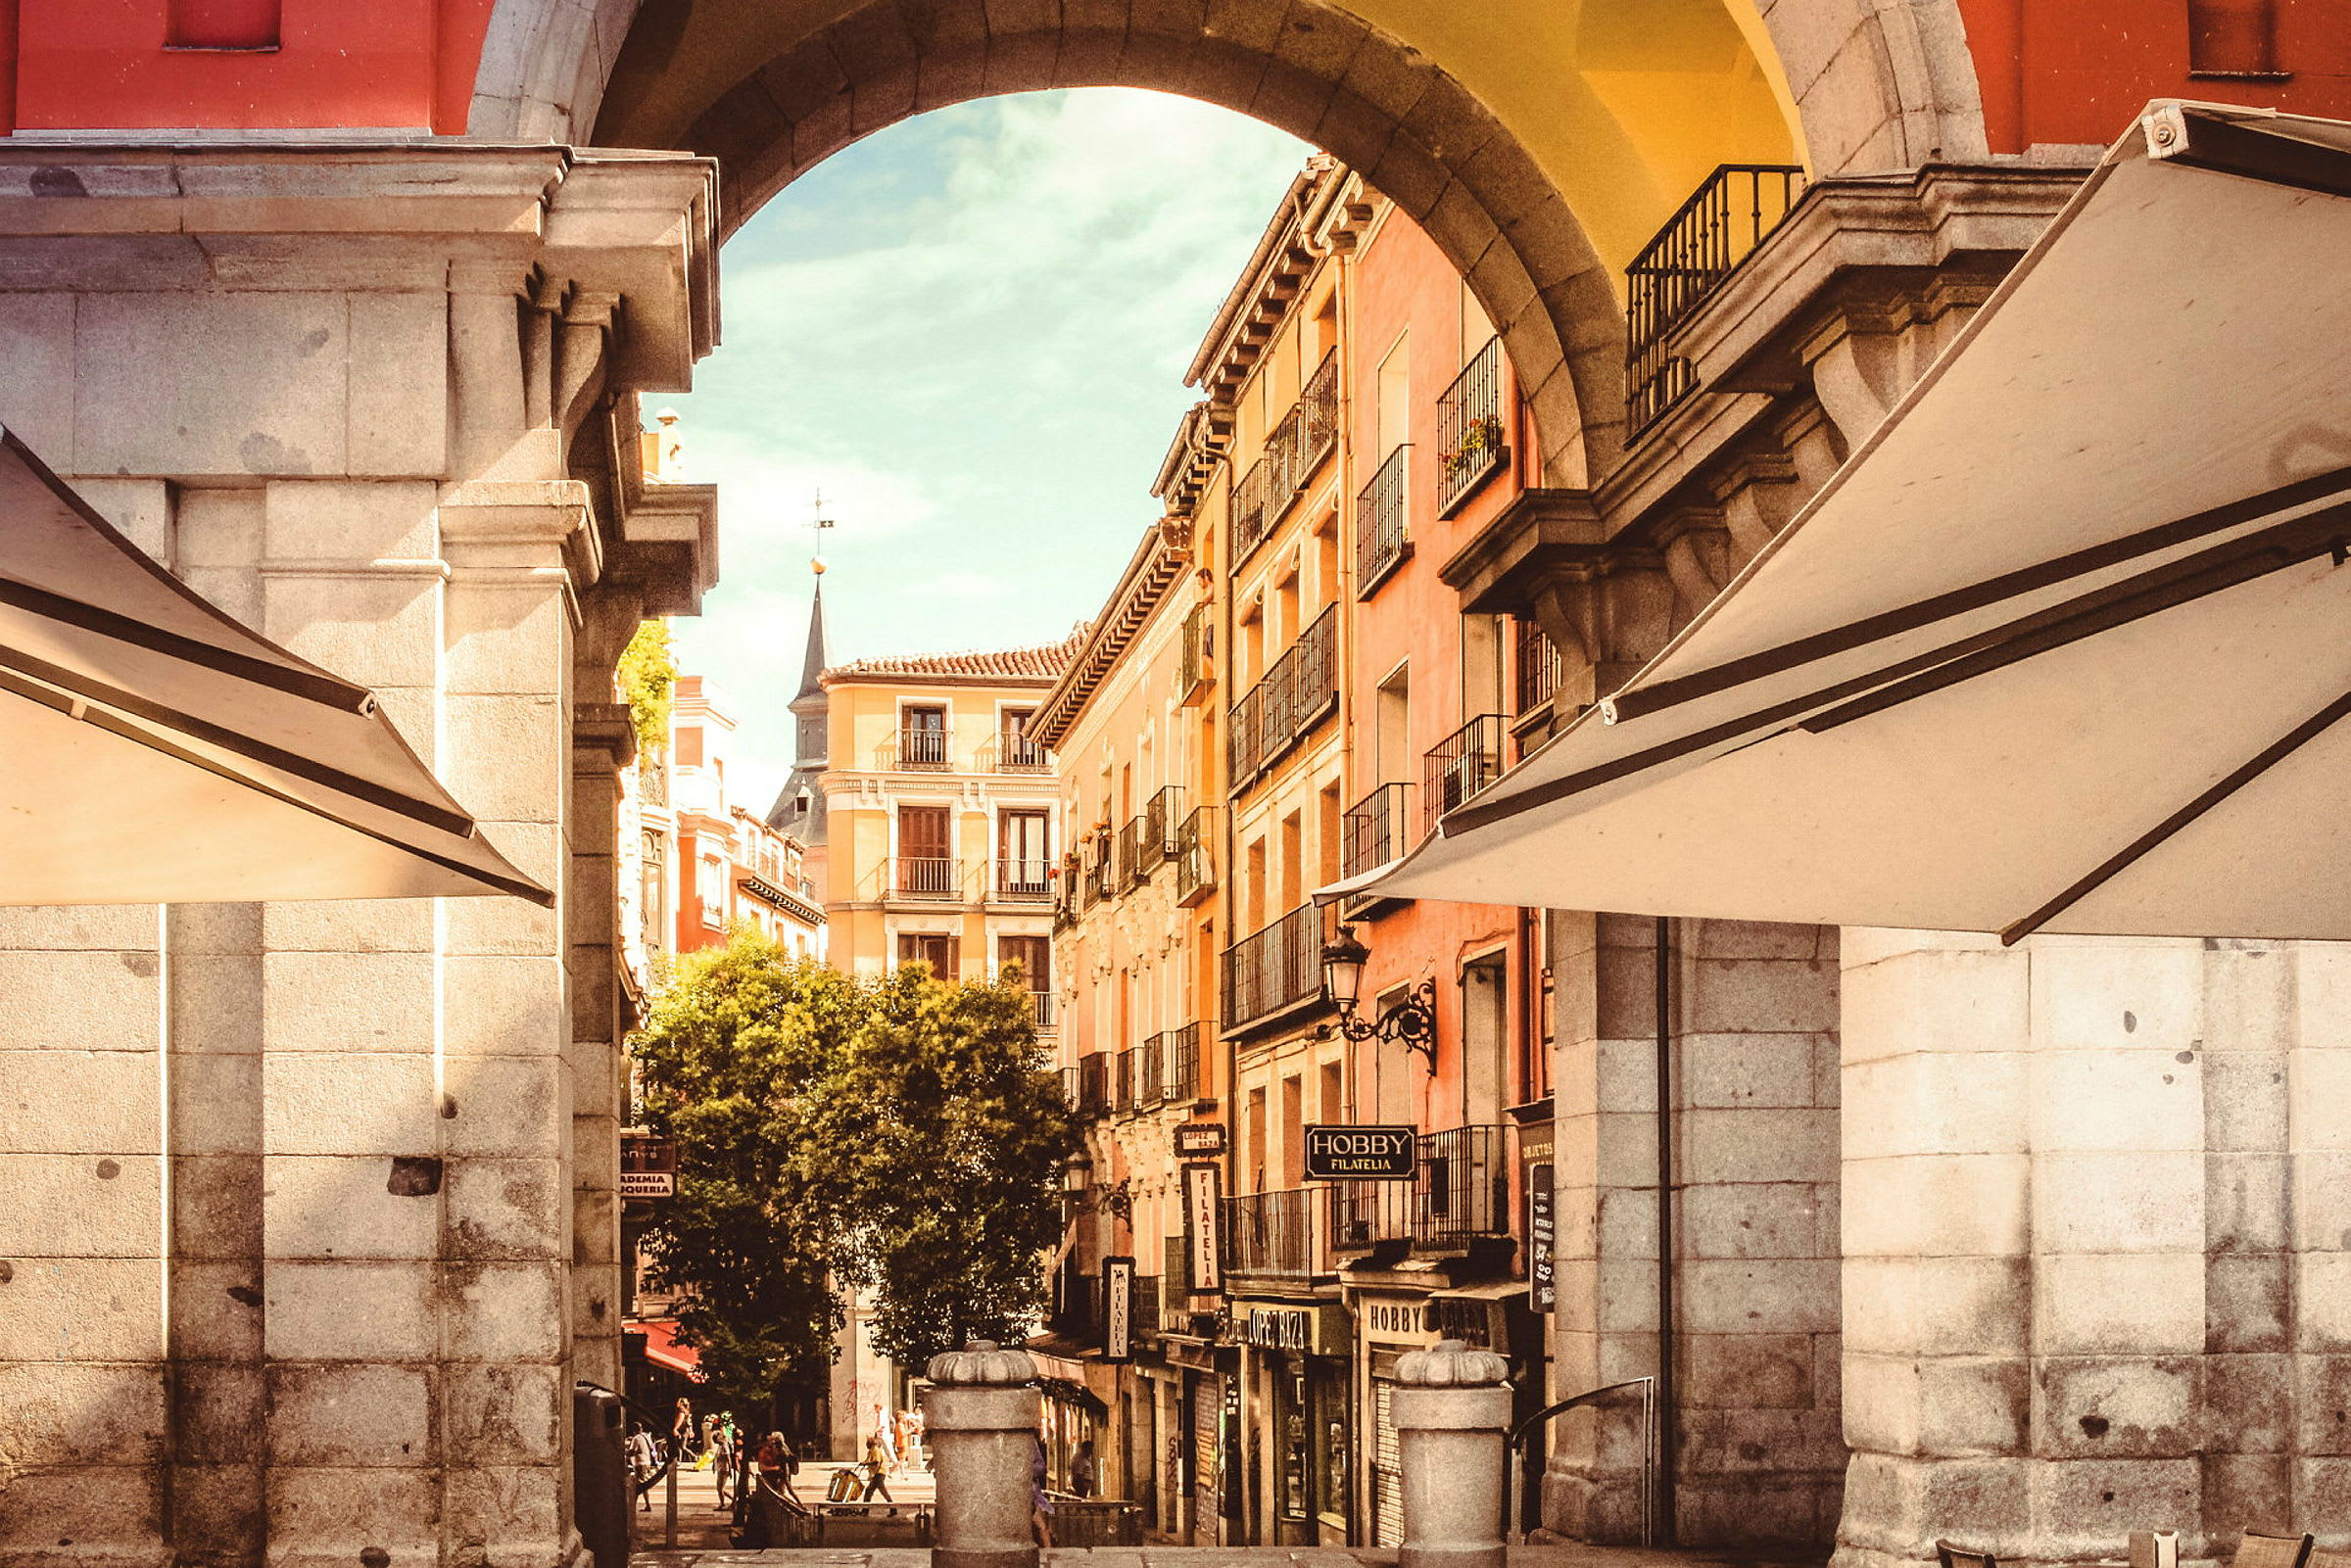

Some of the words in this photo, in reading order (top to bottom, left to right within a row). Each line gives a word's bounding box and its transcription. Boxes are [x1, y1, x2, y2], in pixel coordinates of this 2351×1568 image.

[1314, 1134, 1408, 1155] HOBBY
[1331, 1159, 1391, 1170] FILATELIA
[1200, 1172, 1213, 1287] FILATELIA
[1370, 1305, 1420, 1333] HOBBY
